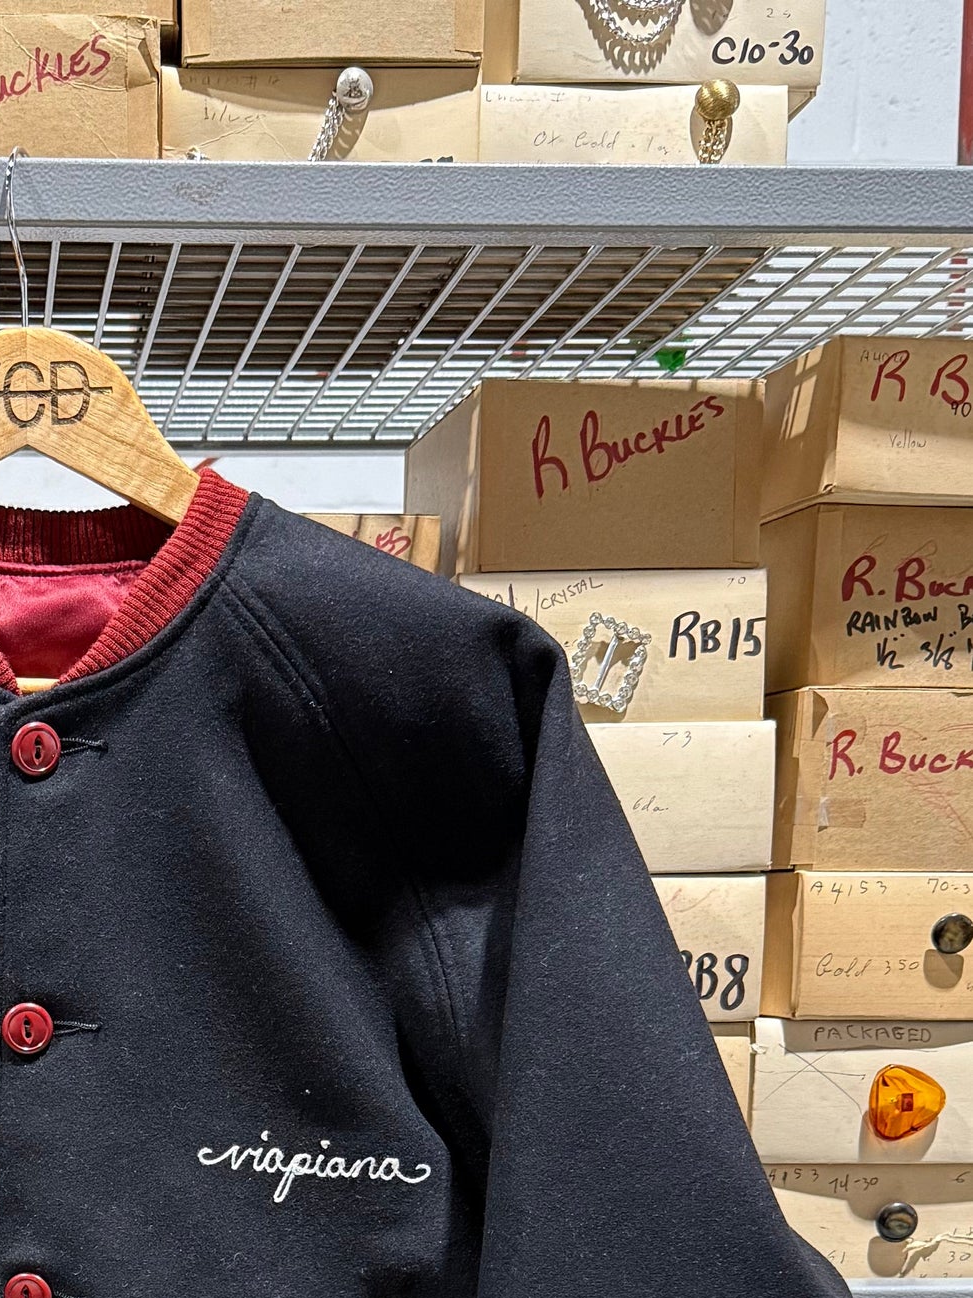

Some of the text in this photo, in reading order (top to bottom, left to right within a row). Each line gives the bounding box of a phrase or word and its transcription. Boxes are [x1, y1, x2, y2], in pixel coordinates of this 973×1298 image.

[712, 30, 815, 65] C10-30
[870, 350, 910, 402] R
[531, 415, 569, 499] R
[814, 1025, 932, 1043] PACKAGED
[197, 1130, 431, 1203] viapiana
